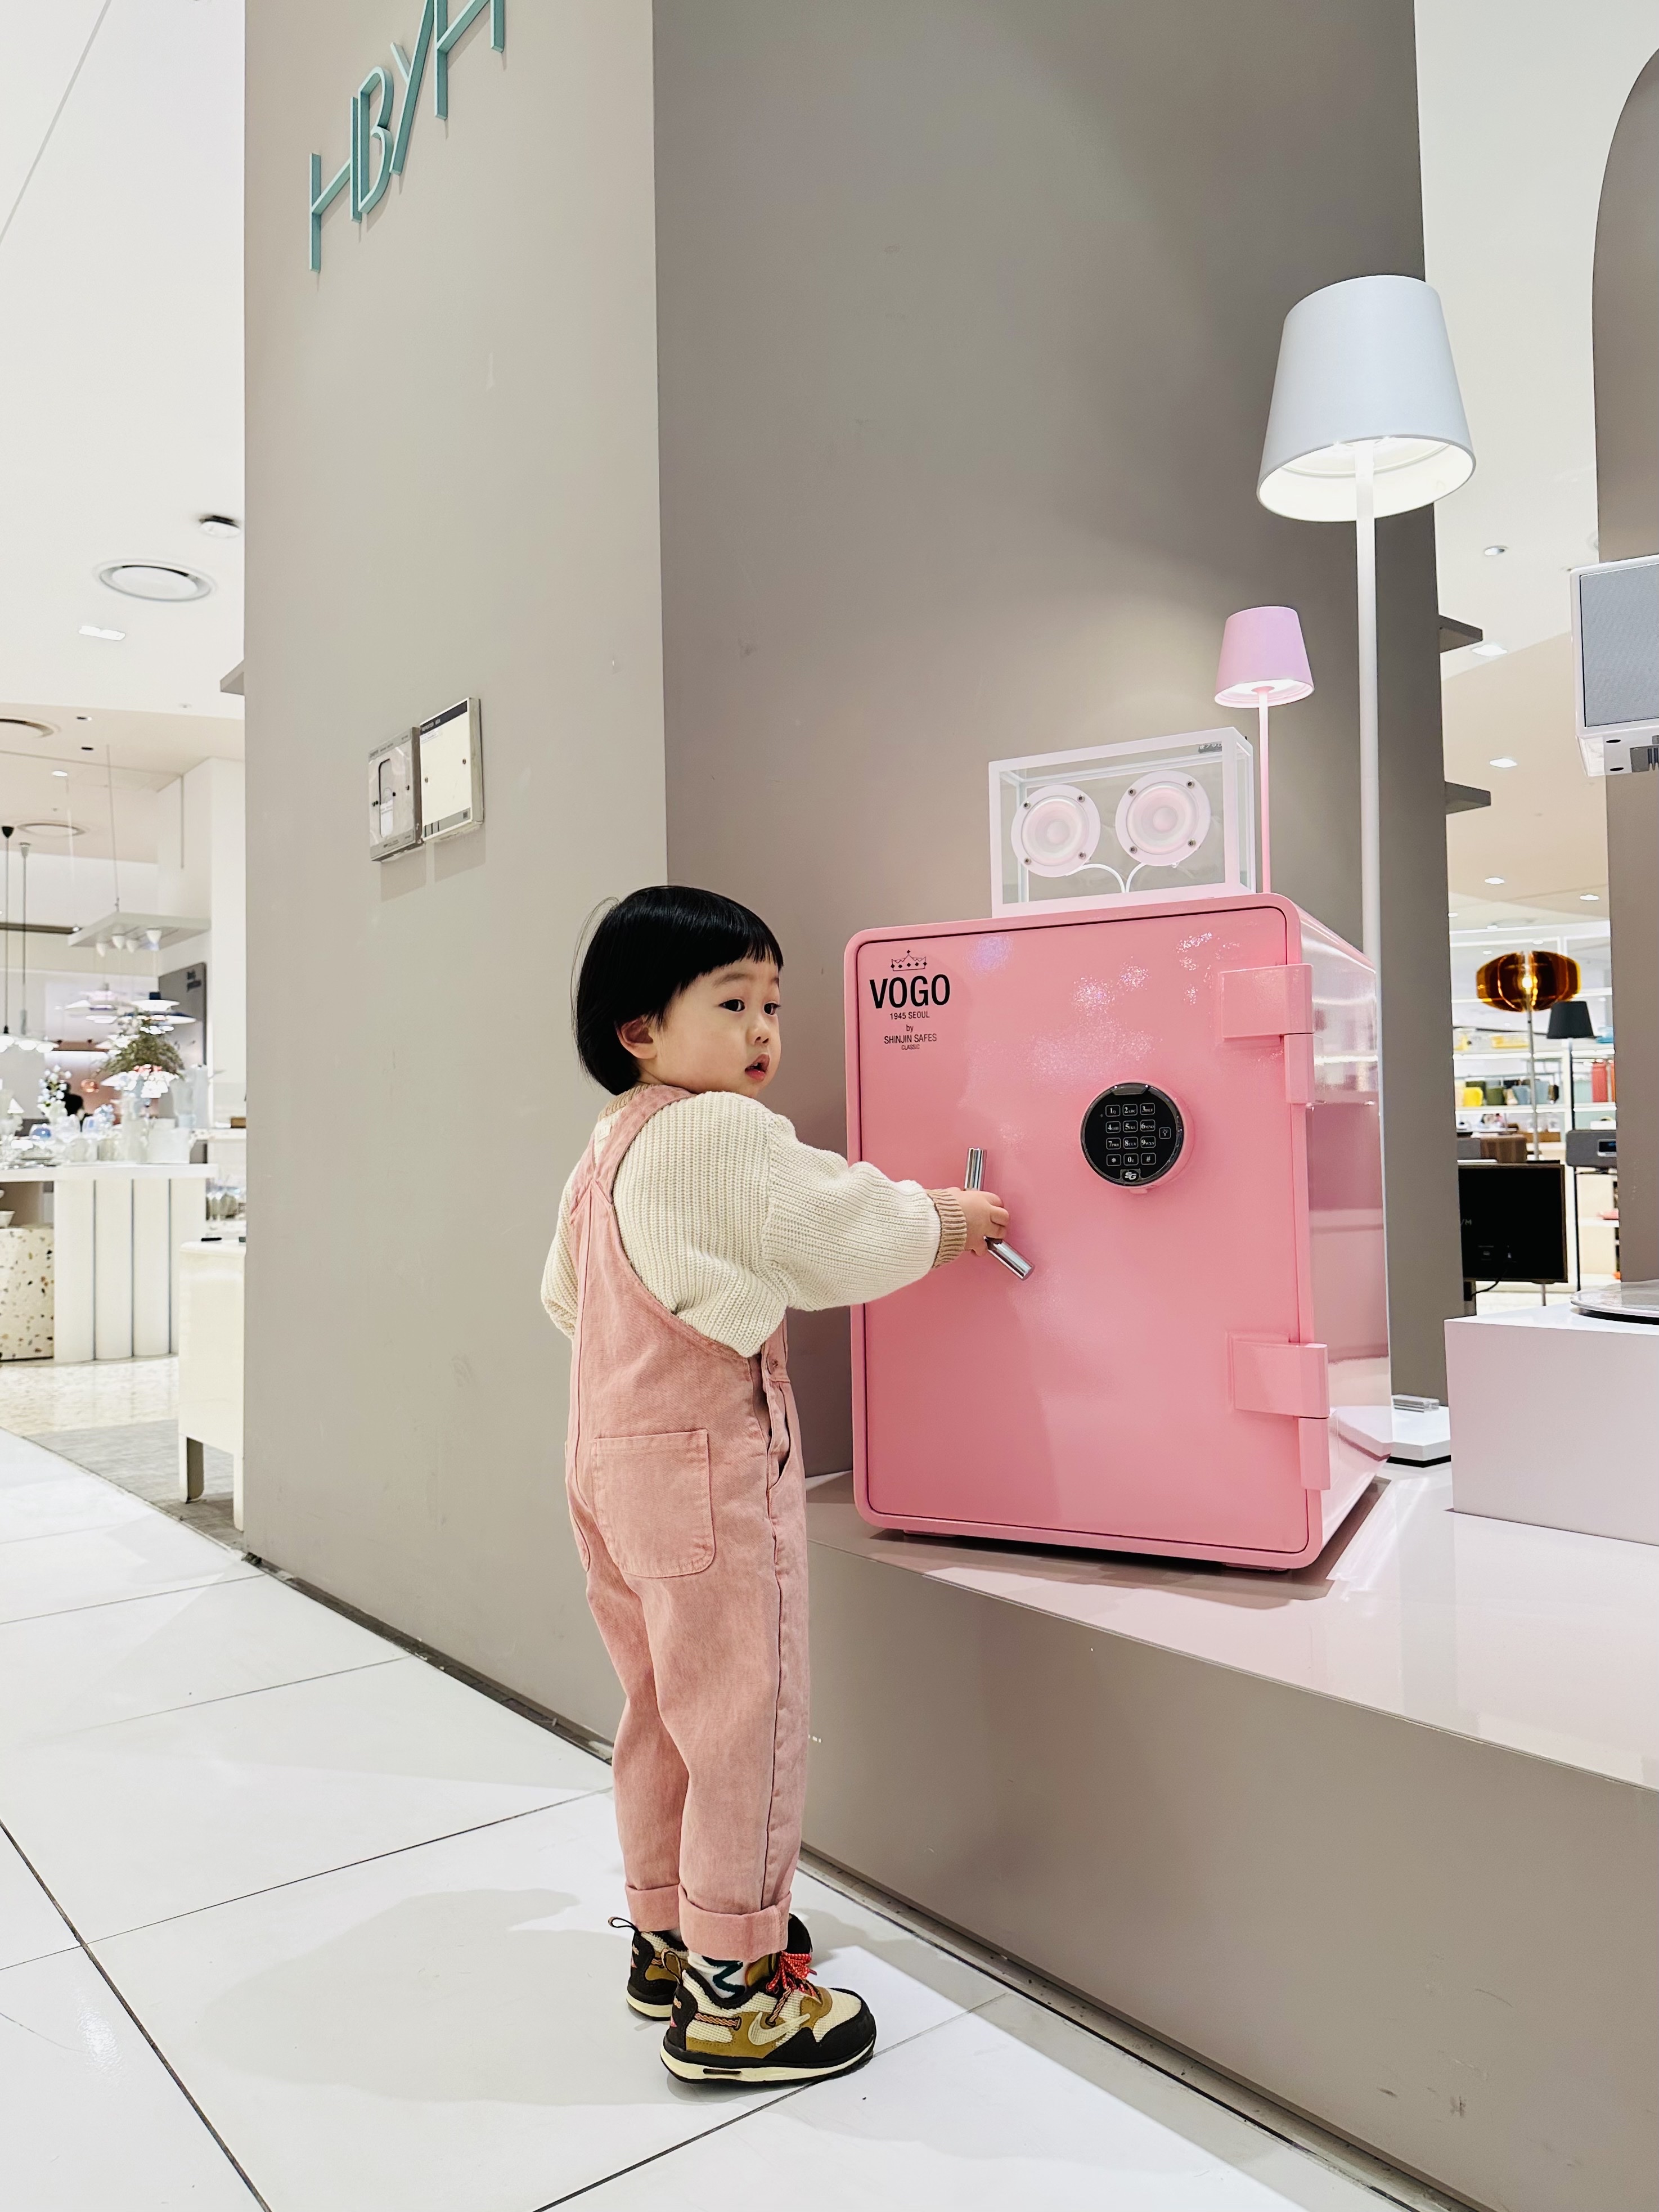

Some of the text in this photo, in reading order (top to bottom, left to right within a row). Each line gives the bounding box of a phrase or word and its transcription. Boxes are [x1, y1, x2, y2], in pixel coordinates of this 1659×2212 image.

[870, 974, 950, 1009] VOGO
[908, 1010, 930, 1019] SEOUL
[906, 1024, 914, 1033] by
[884, 1033, 937, 1044] SHINJIN SAFES
